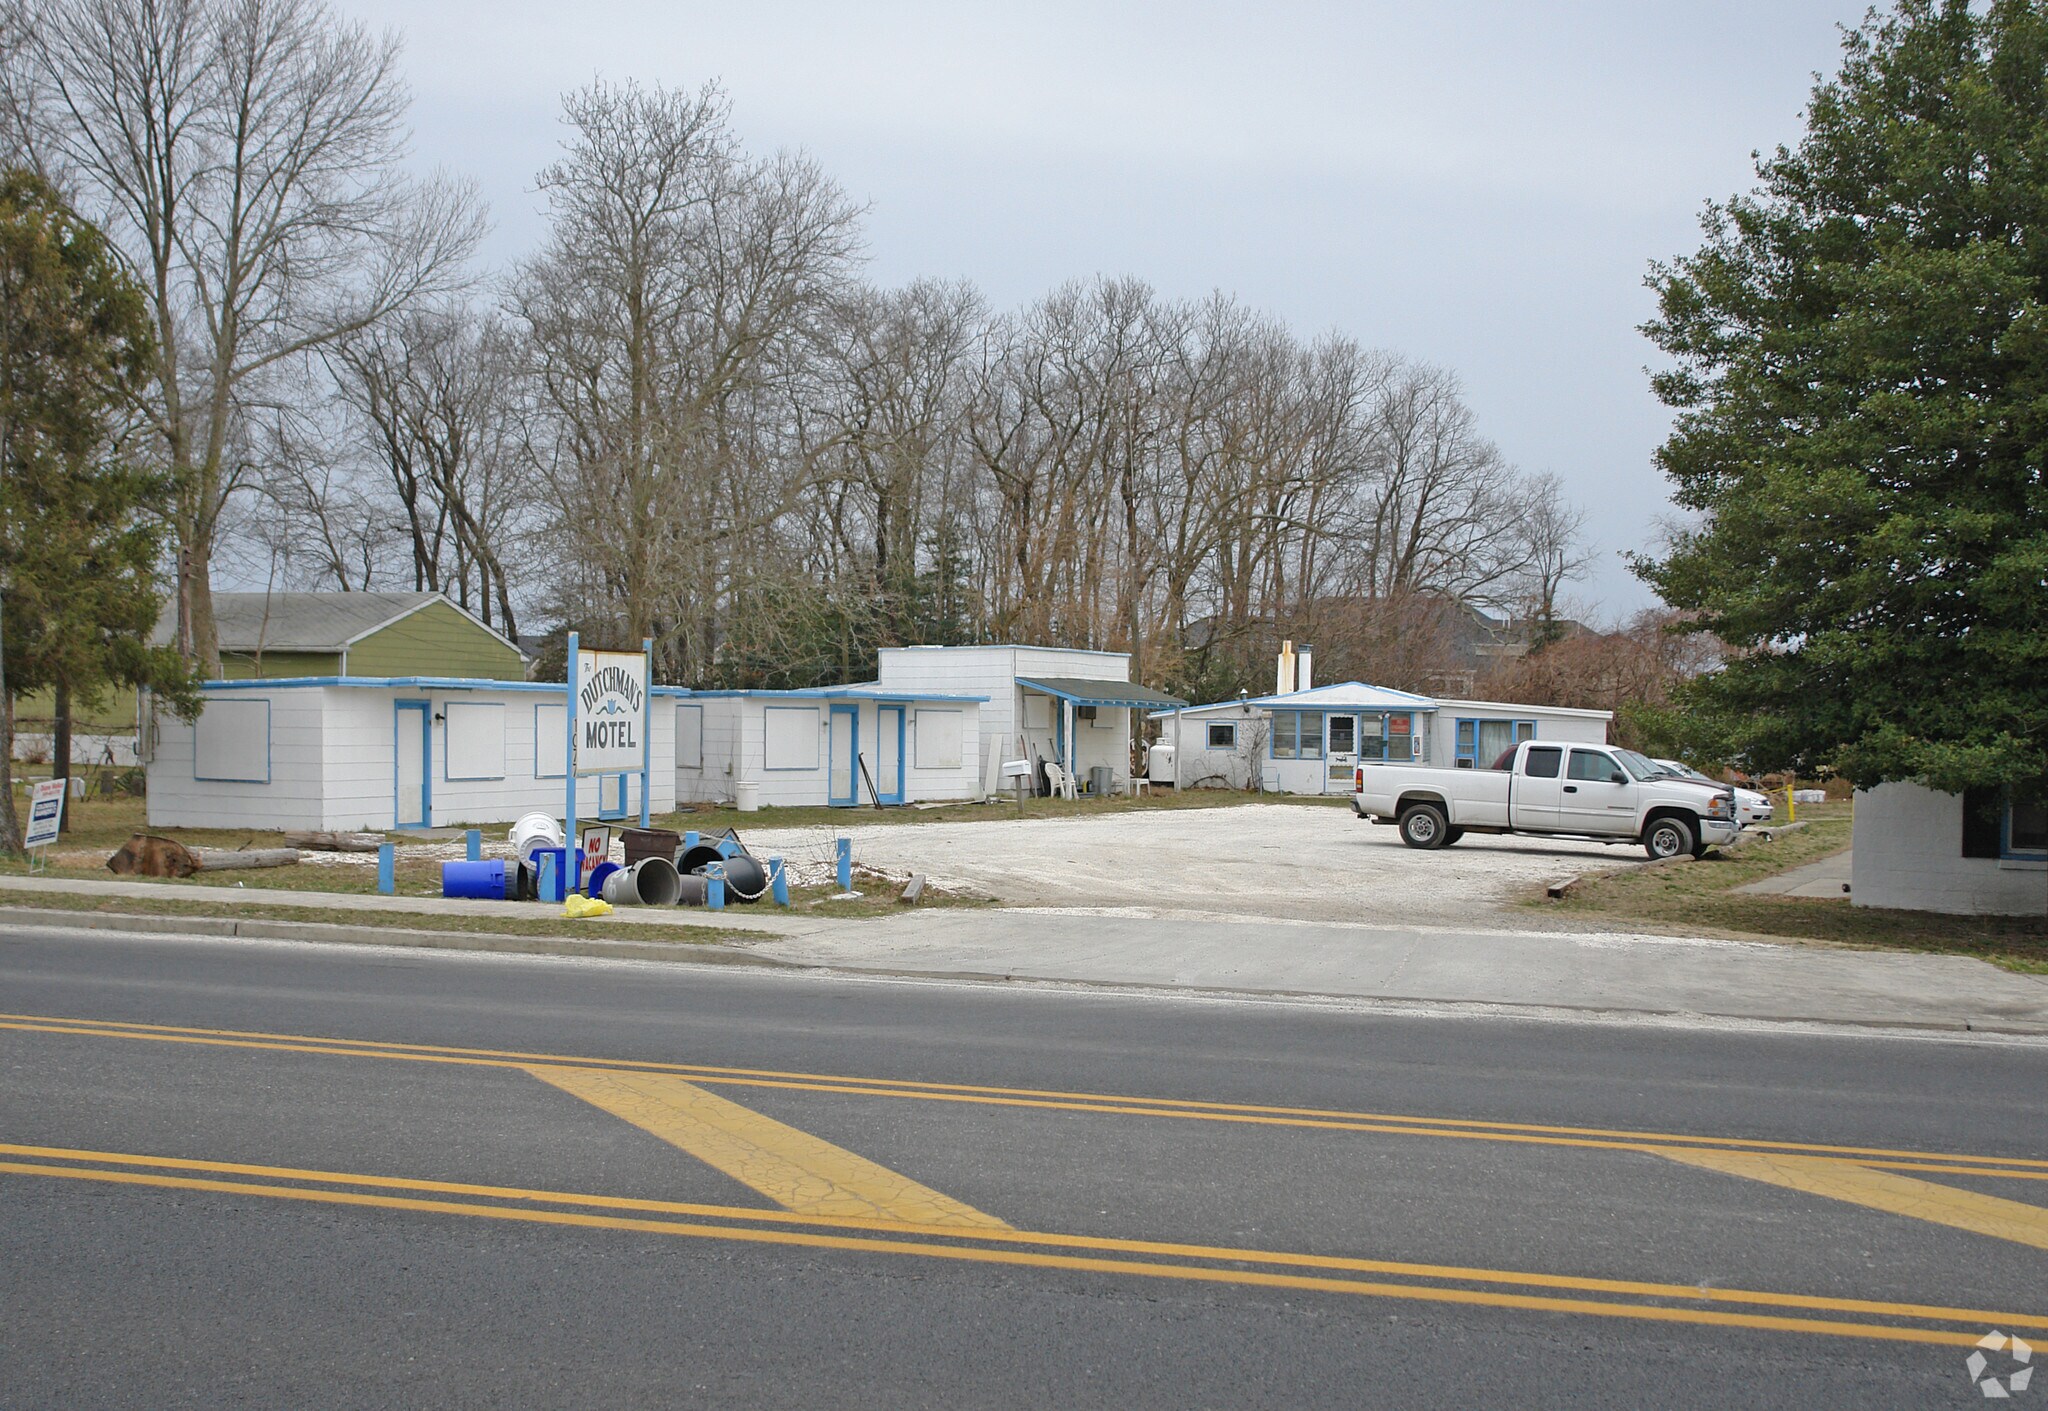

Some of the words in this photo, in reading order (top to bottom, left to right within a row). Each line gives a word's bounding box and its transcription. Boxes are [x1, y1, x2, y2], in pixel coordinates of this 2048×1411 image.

[580, 666, 643, 714] DUTCHMAN'S
[586, 721, 636, 749] MOTEL
[588, 837, 601, 853] NO
